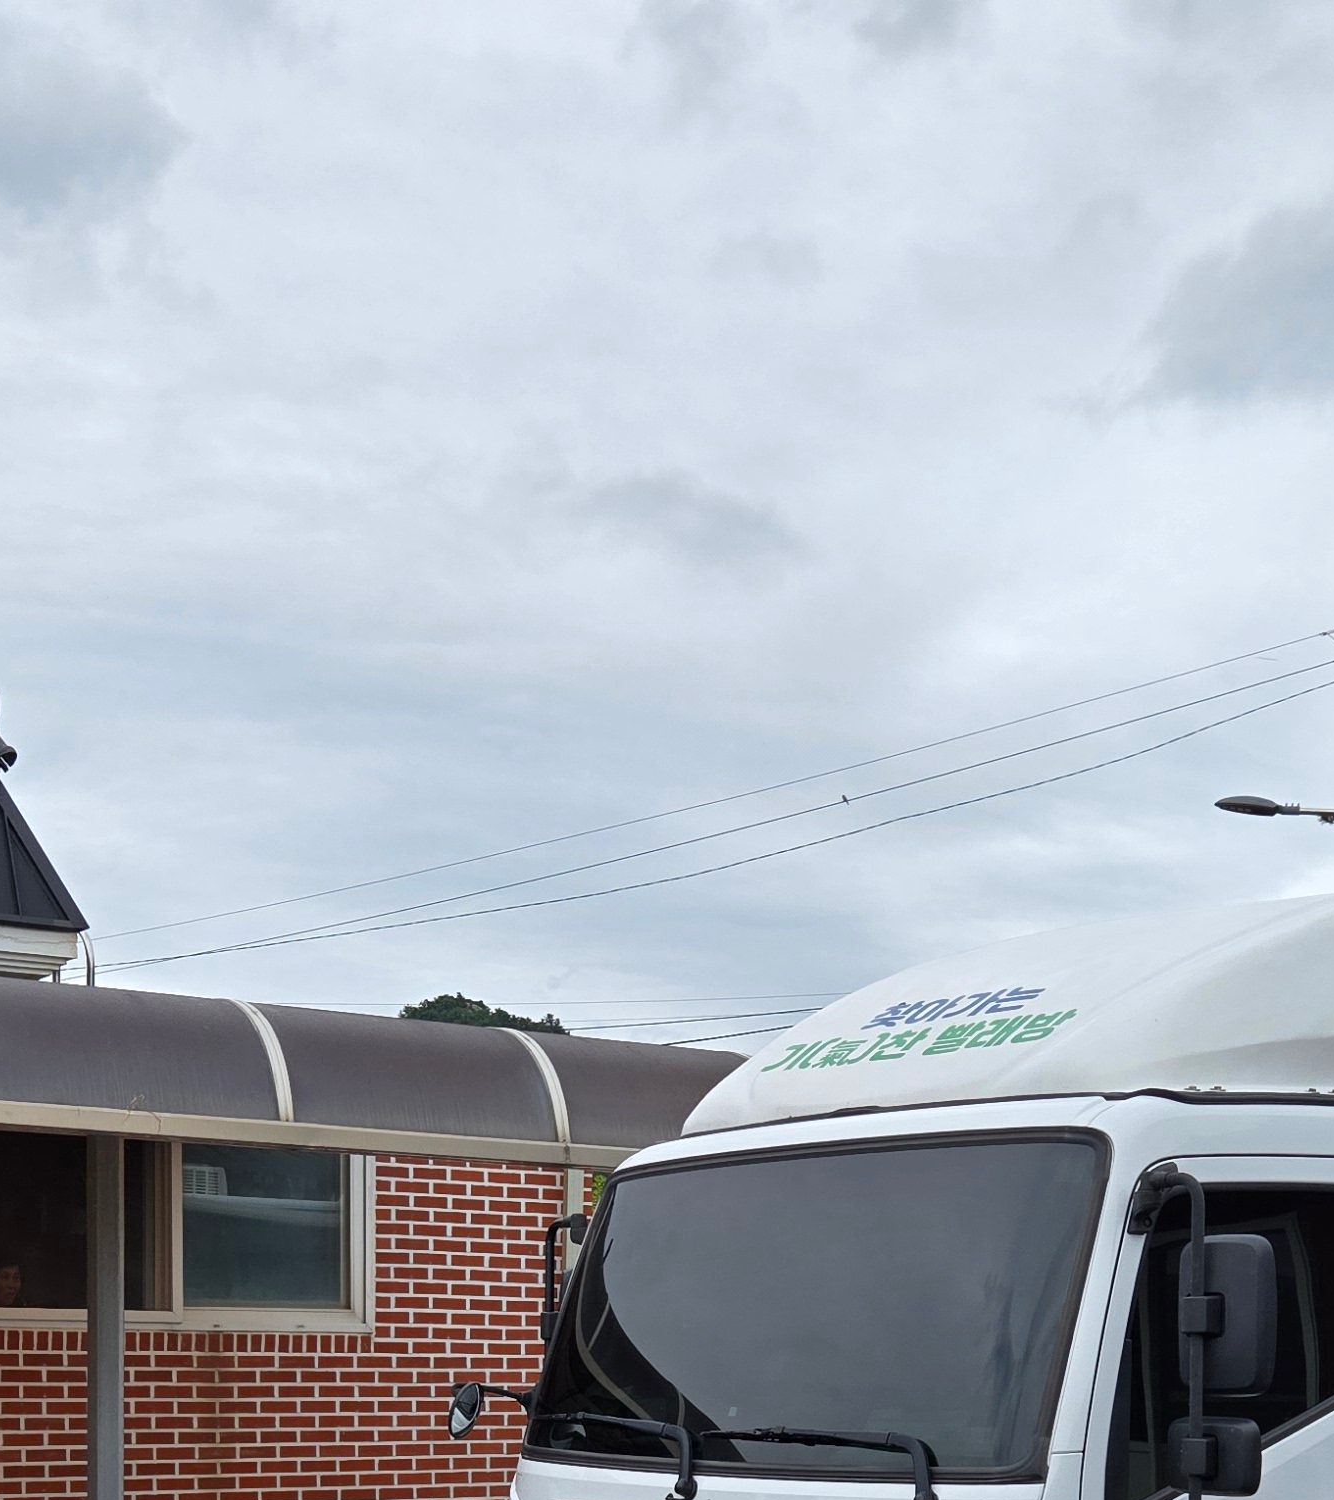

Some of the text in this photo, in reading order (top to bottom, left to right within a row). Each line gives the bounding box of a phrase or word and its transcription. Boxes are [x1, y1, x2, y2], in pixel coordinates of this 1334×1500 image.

[861, 986, 1046, 1030] 찾아가는
[761, 1008, 1078, 1072] 기(氣)찬 빨래방
